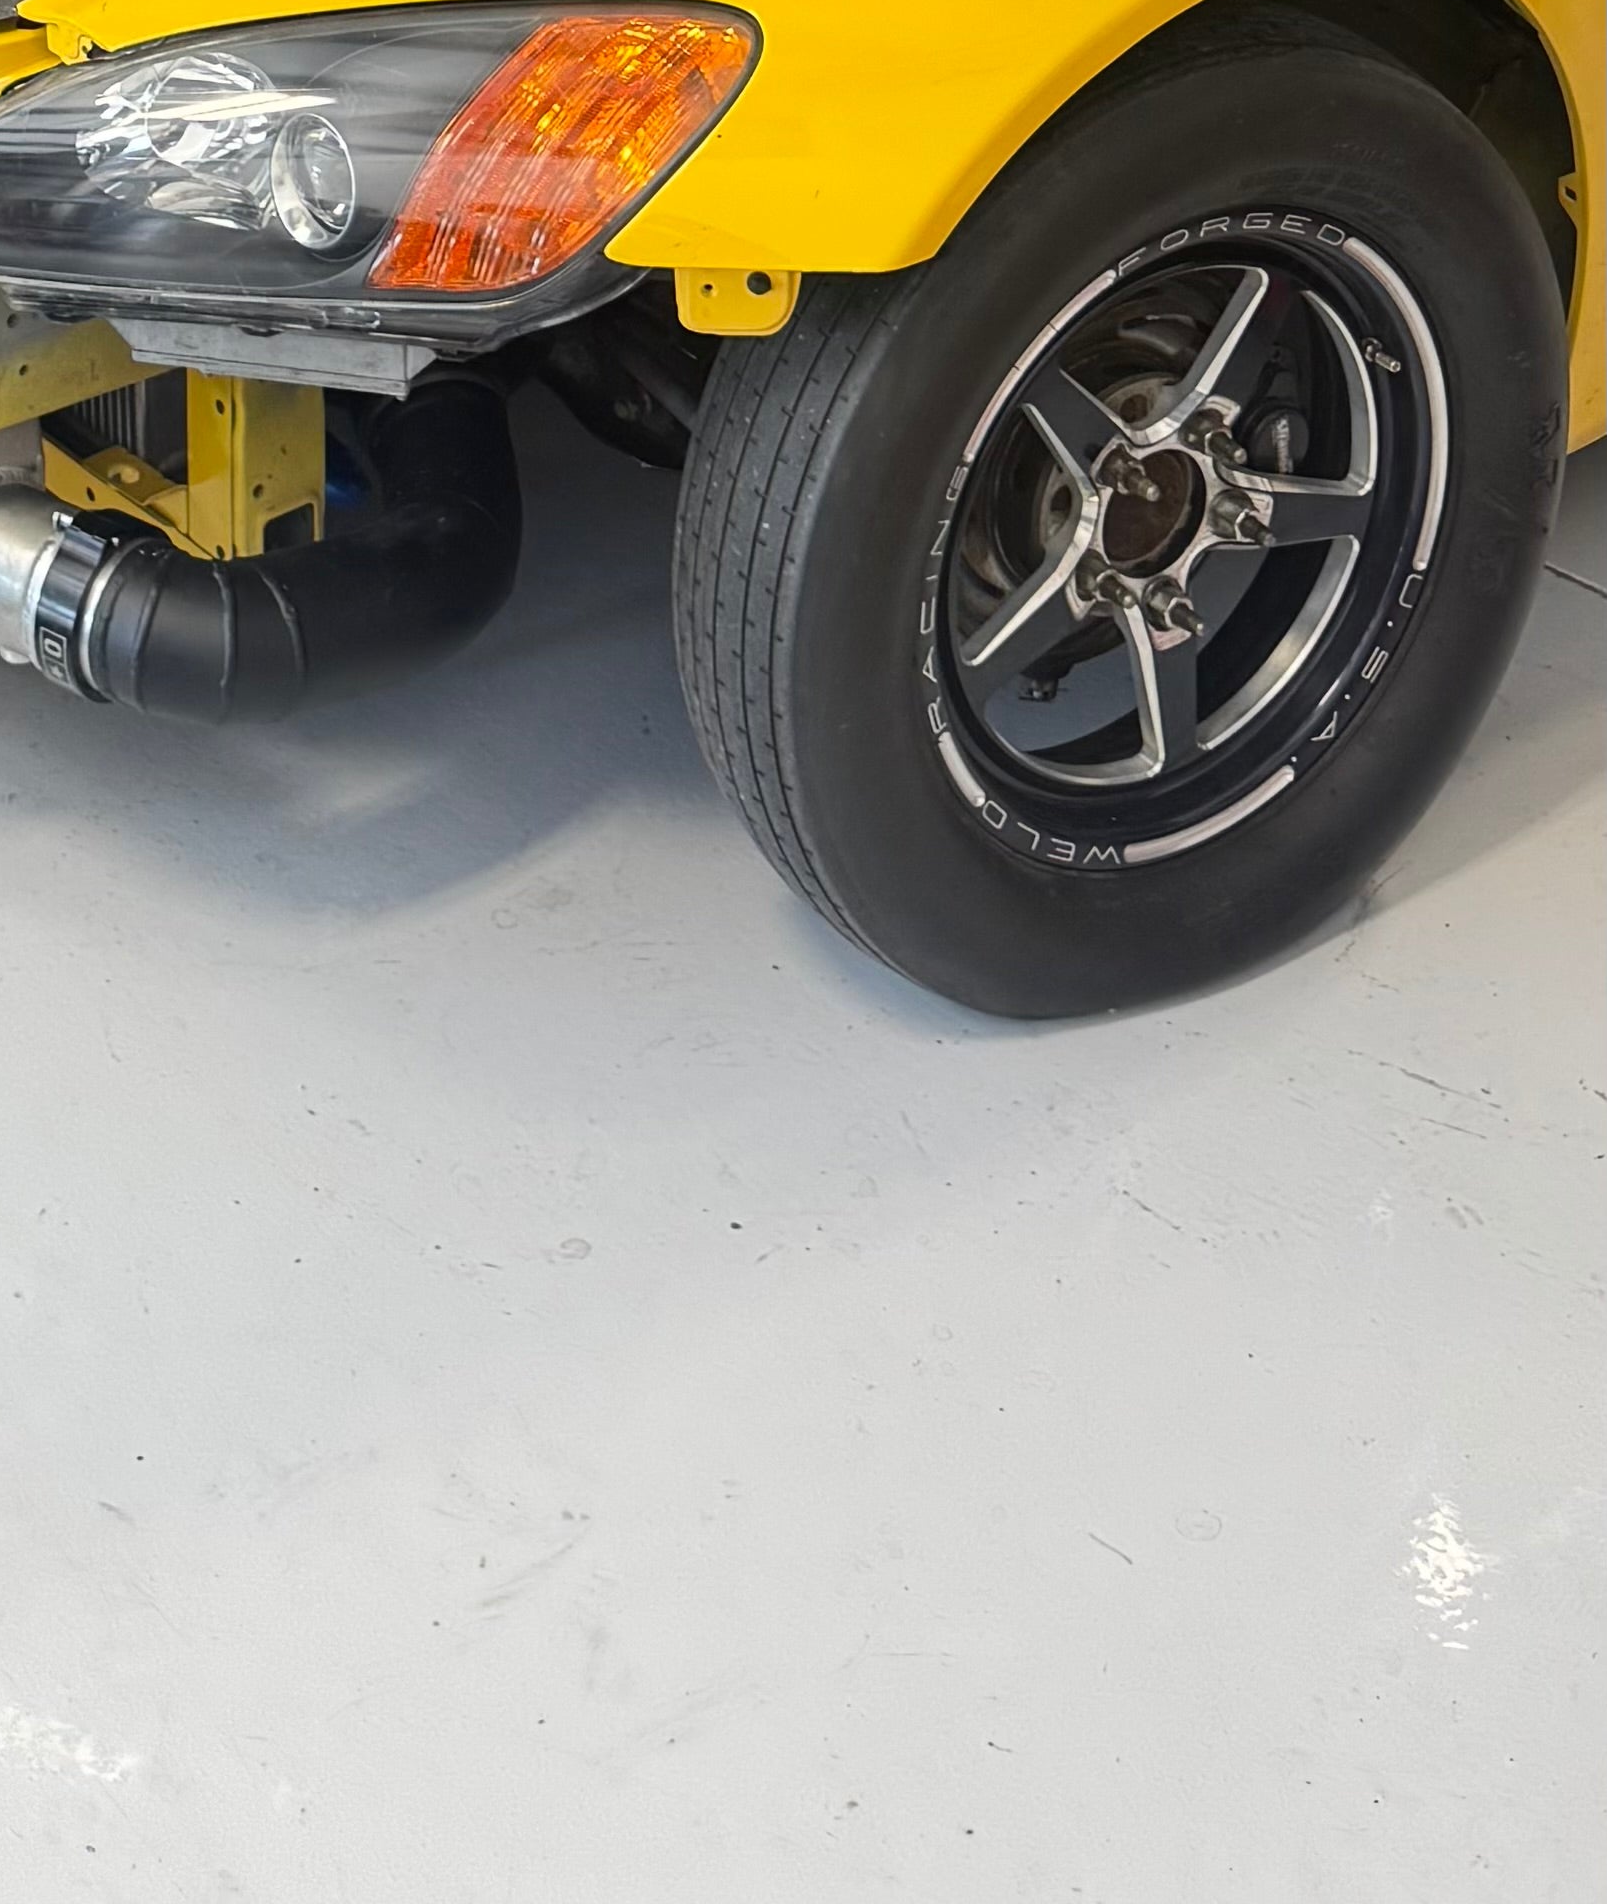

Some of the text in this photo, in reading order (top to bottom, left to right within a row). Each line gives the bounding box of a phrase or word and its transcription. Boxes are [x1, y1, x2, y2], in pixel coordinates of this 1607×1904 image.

[1114, 211, 1347, 278] FORGED
[922, 462, 971, 750] RACING
[979, 796, 1123, 865] WELD
